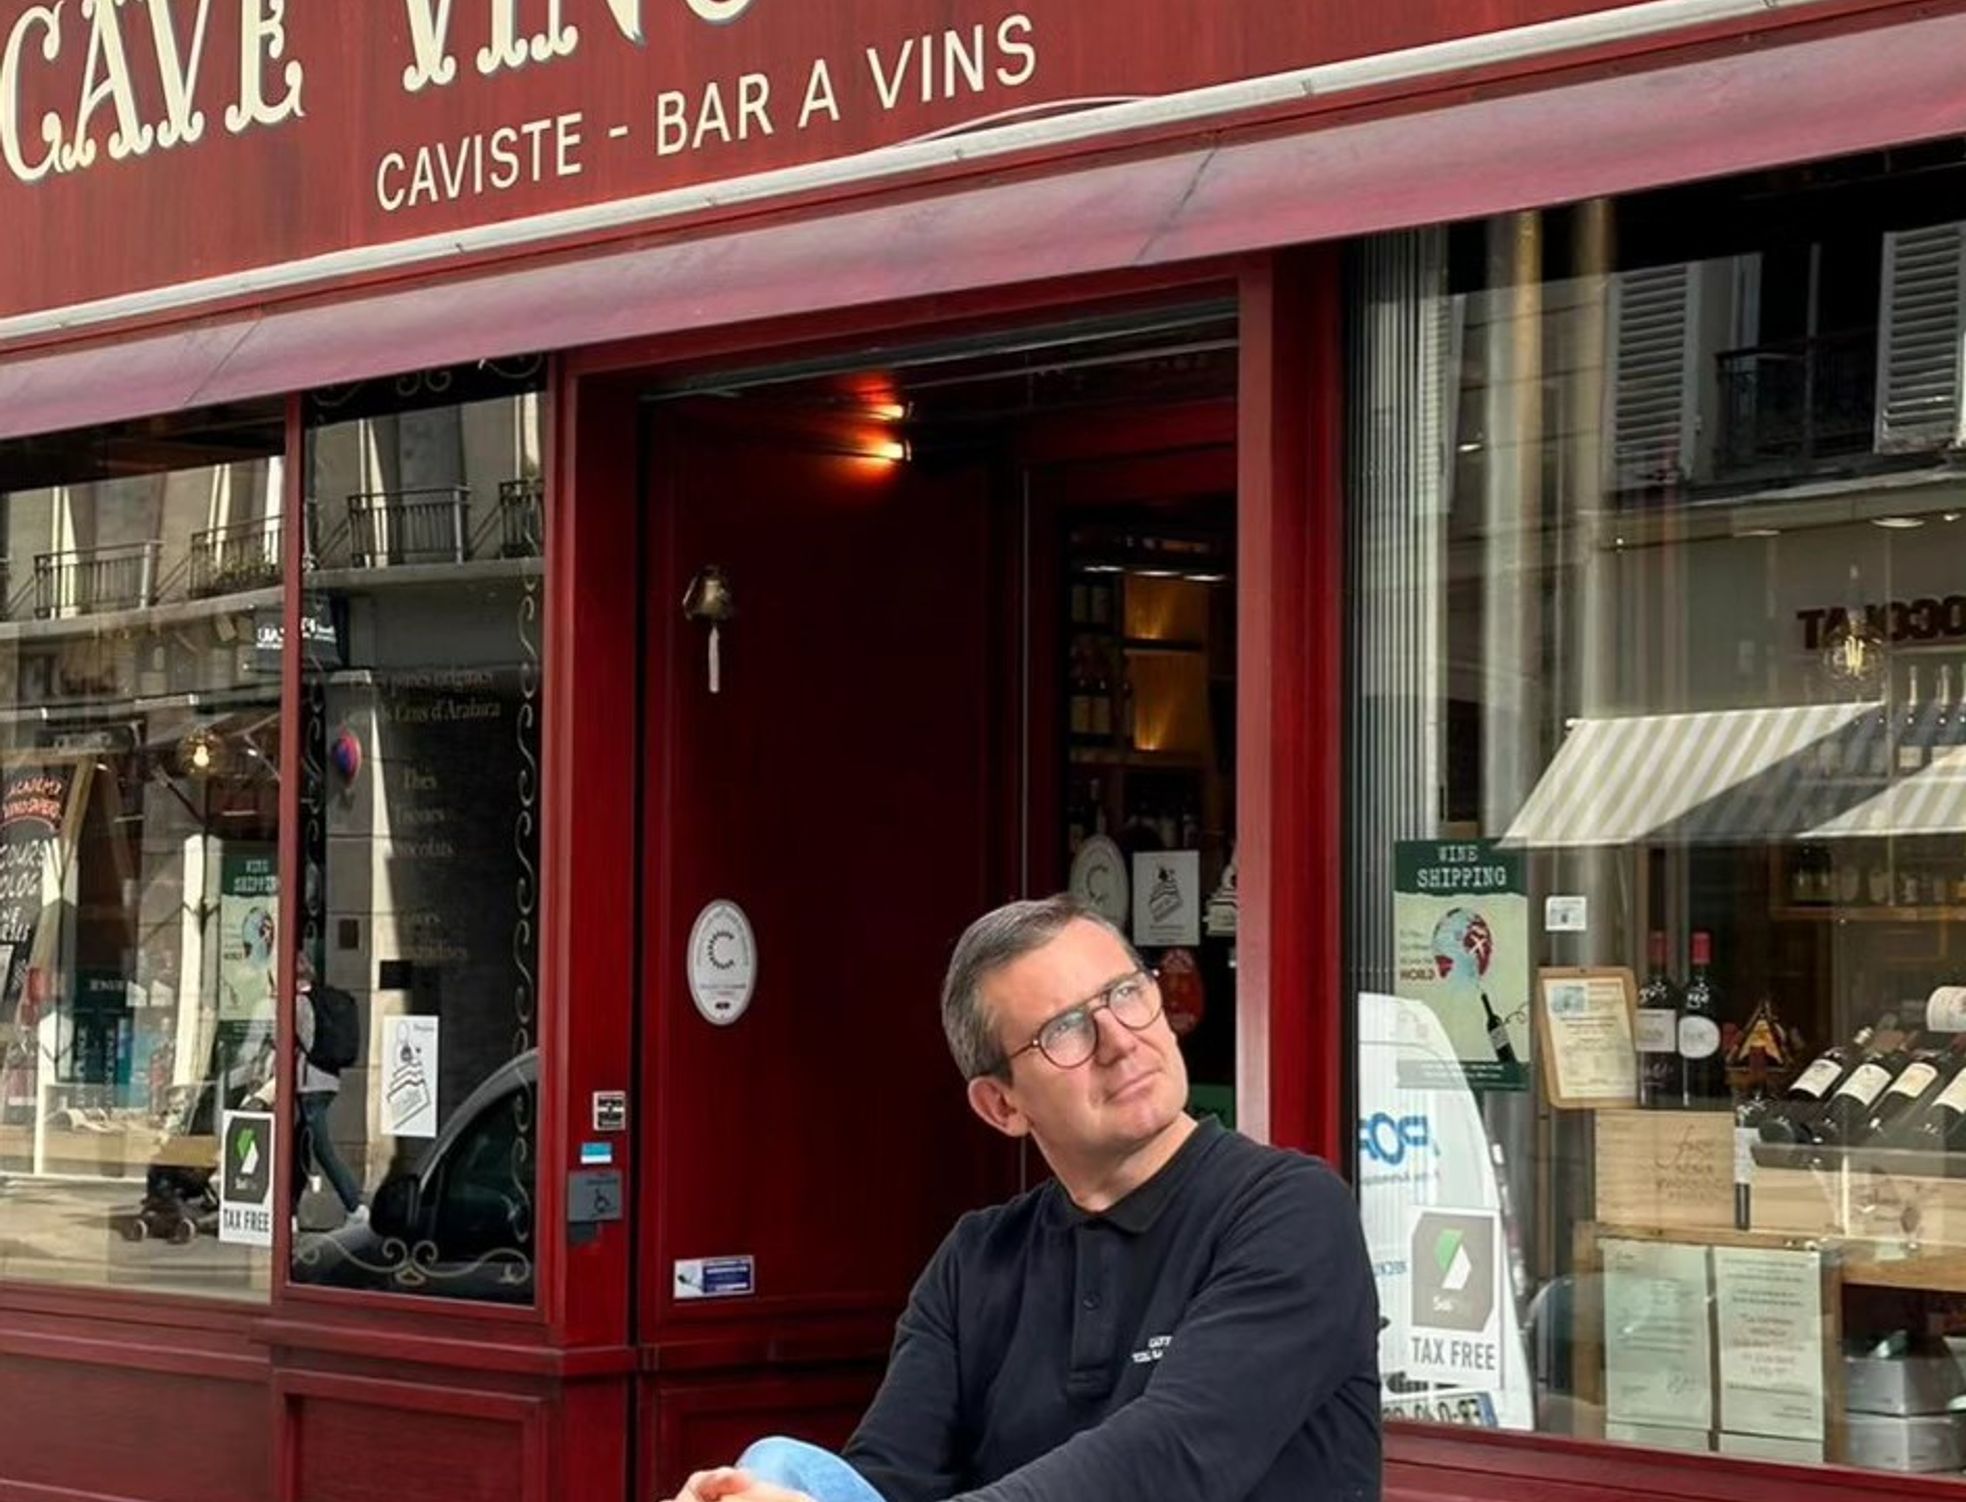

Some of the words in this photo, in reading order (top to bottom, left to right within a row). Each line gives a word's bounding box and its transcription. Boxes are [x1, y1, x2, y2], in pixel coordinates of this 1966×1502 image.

[0, 0, 305, 181] CAVE
[377, 113, 583, 211] CAVISTE
[656, 73, 771, 155] BAR
[799, 59, 840, 128] A
[868, 15, 1037, 109] VINS
[1417, 867, 1506, 888] SHIPPING
[224, 1209, 241, 1229] TAX
[244, 1211, 269, 1232] FREE
[1412, 1337, 1445, 1365] TAX
[1451, 1340, 1495, 1371] FREE
